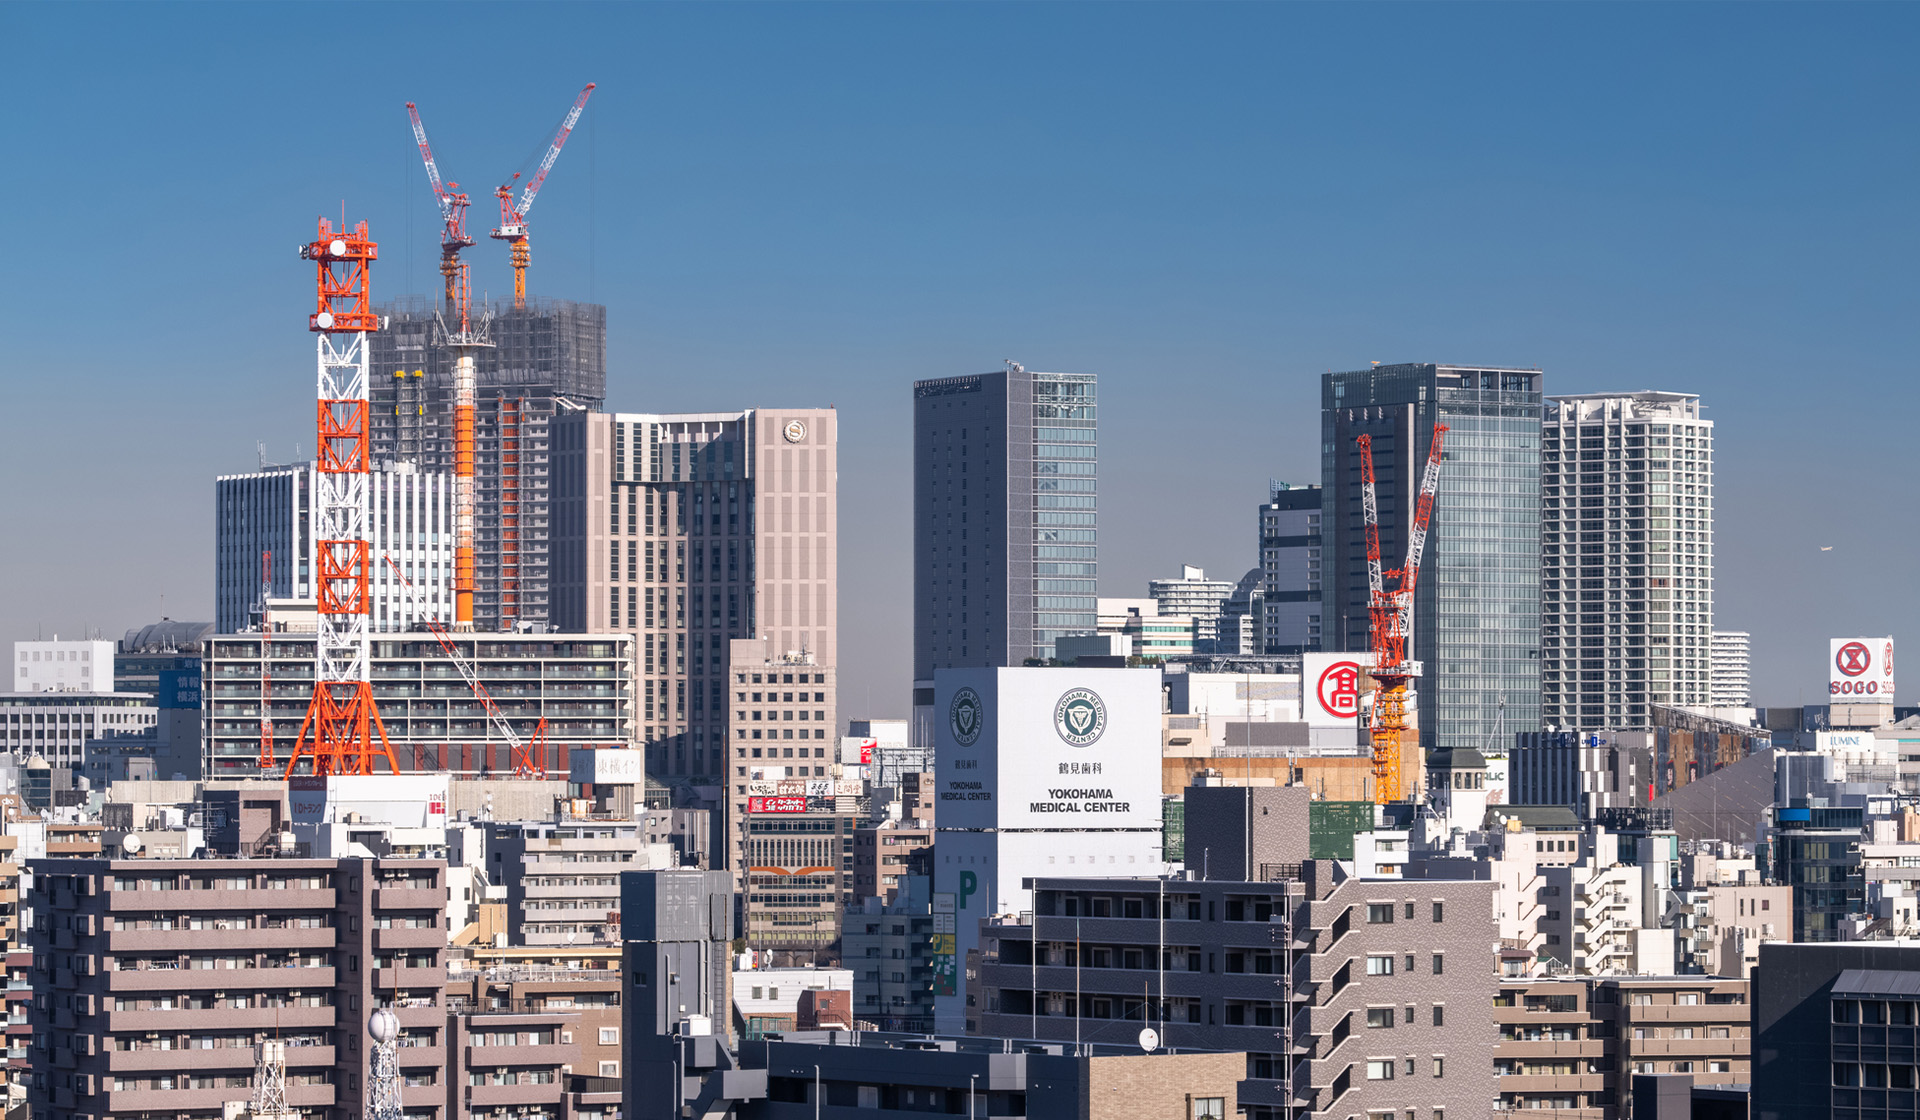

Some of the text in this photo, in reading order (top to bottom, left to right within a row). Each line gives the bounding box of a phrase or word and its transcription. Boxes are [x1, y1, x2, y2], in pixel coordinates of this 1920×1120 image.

[1830, 680, 1878, 694] SOGO
[1057, 692, 1104, 743] YOKOHAMA MEDICAL CENTER
[1830, 736, 1860, 746] LUMINE
[598, 758, 638, 774] 東横イン
[1058, 762, 1102, 774] 鶴見歯科
[949, 781, 982, 790] YOKOHAMA
[941, 792, 991, 801] MEDICAL CENTER
[1048, 788, 1113, 799] YOKOHAMA
[1030, 802, 1130, 813] MEDICAL CENTER
[959, 870, 978, 909] P
